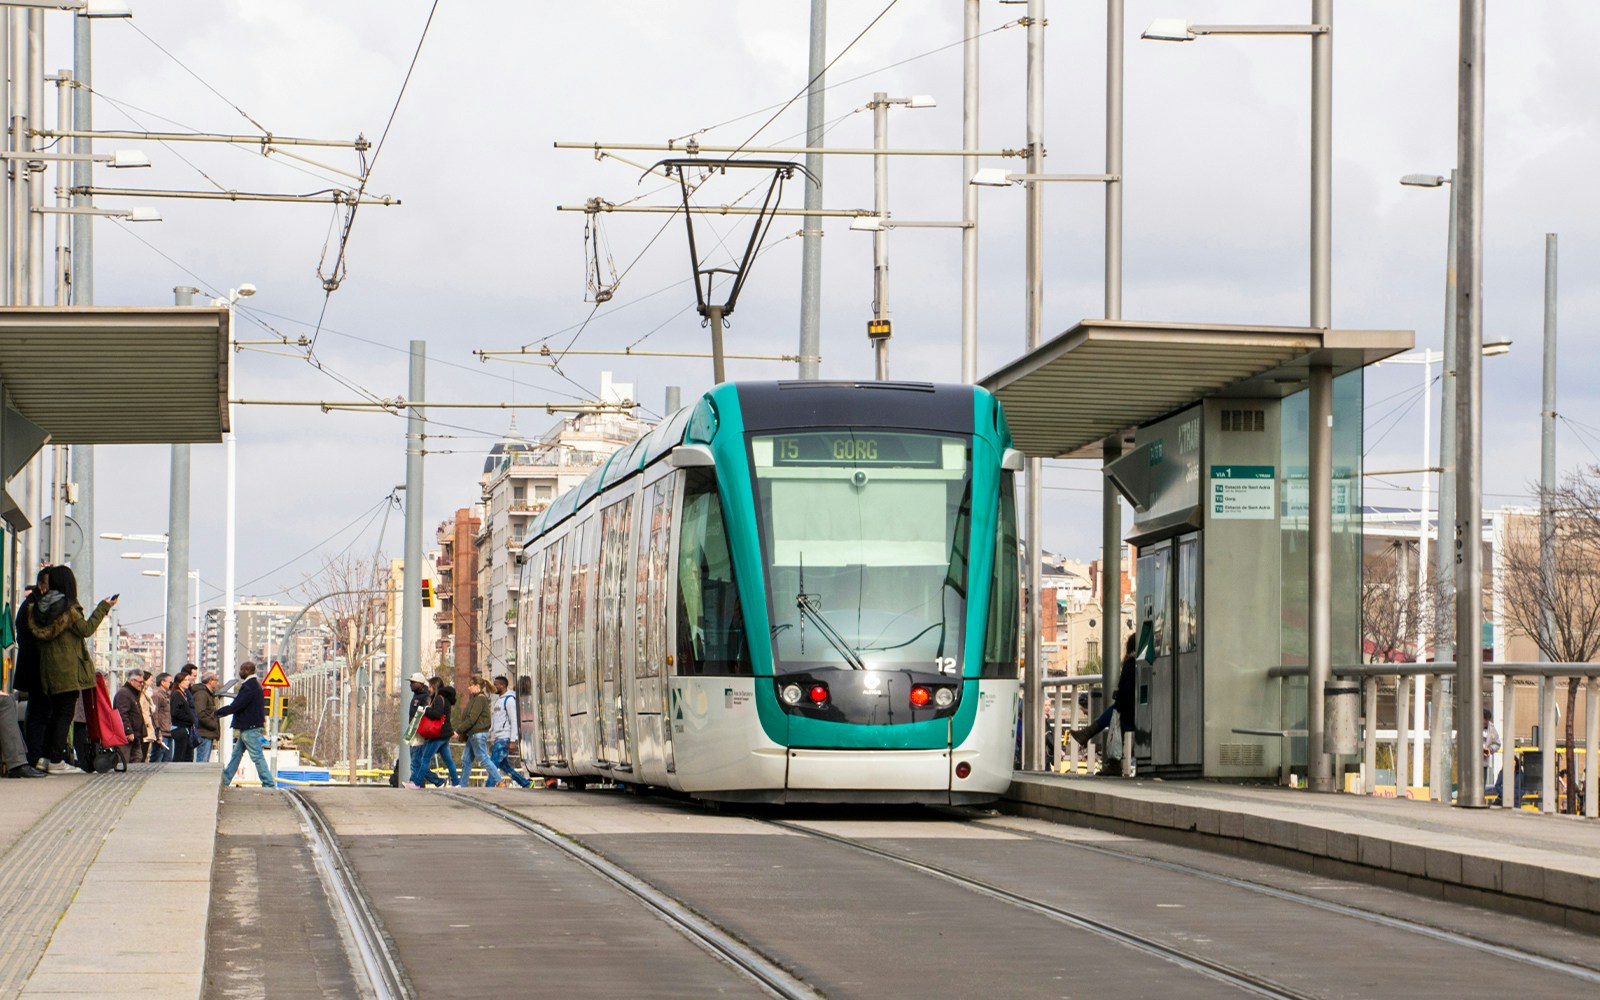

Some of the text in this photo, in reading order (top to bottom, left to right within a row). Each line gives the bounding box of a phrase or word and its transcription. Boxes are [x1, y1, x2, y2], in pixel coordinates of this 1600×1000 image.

[780, 439, 877, 460] T5 GORG
[1226, 468, 1231, 478] 1
[935, 657, 957, 674] 12
